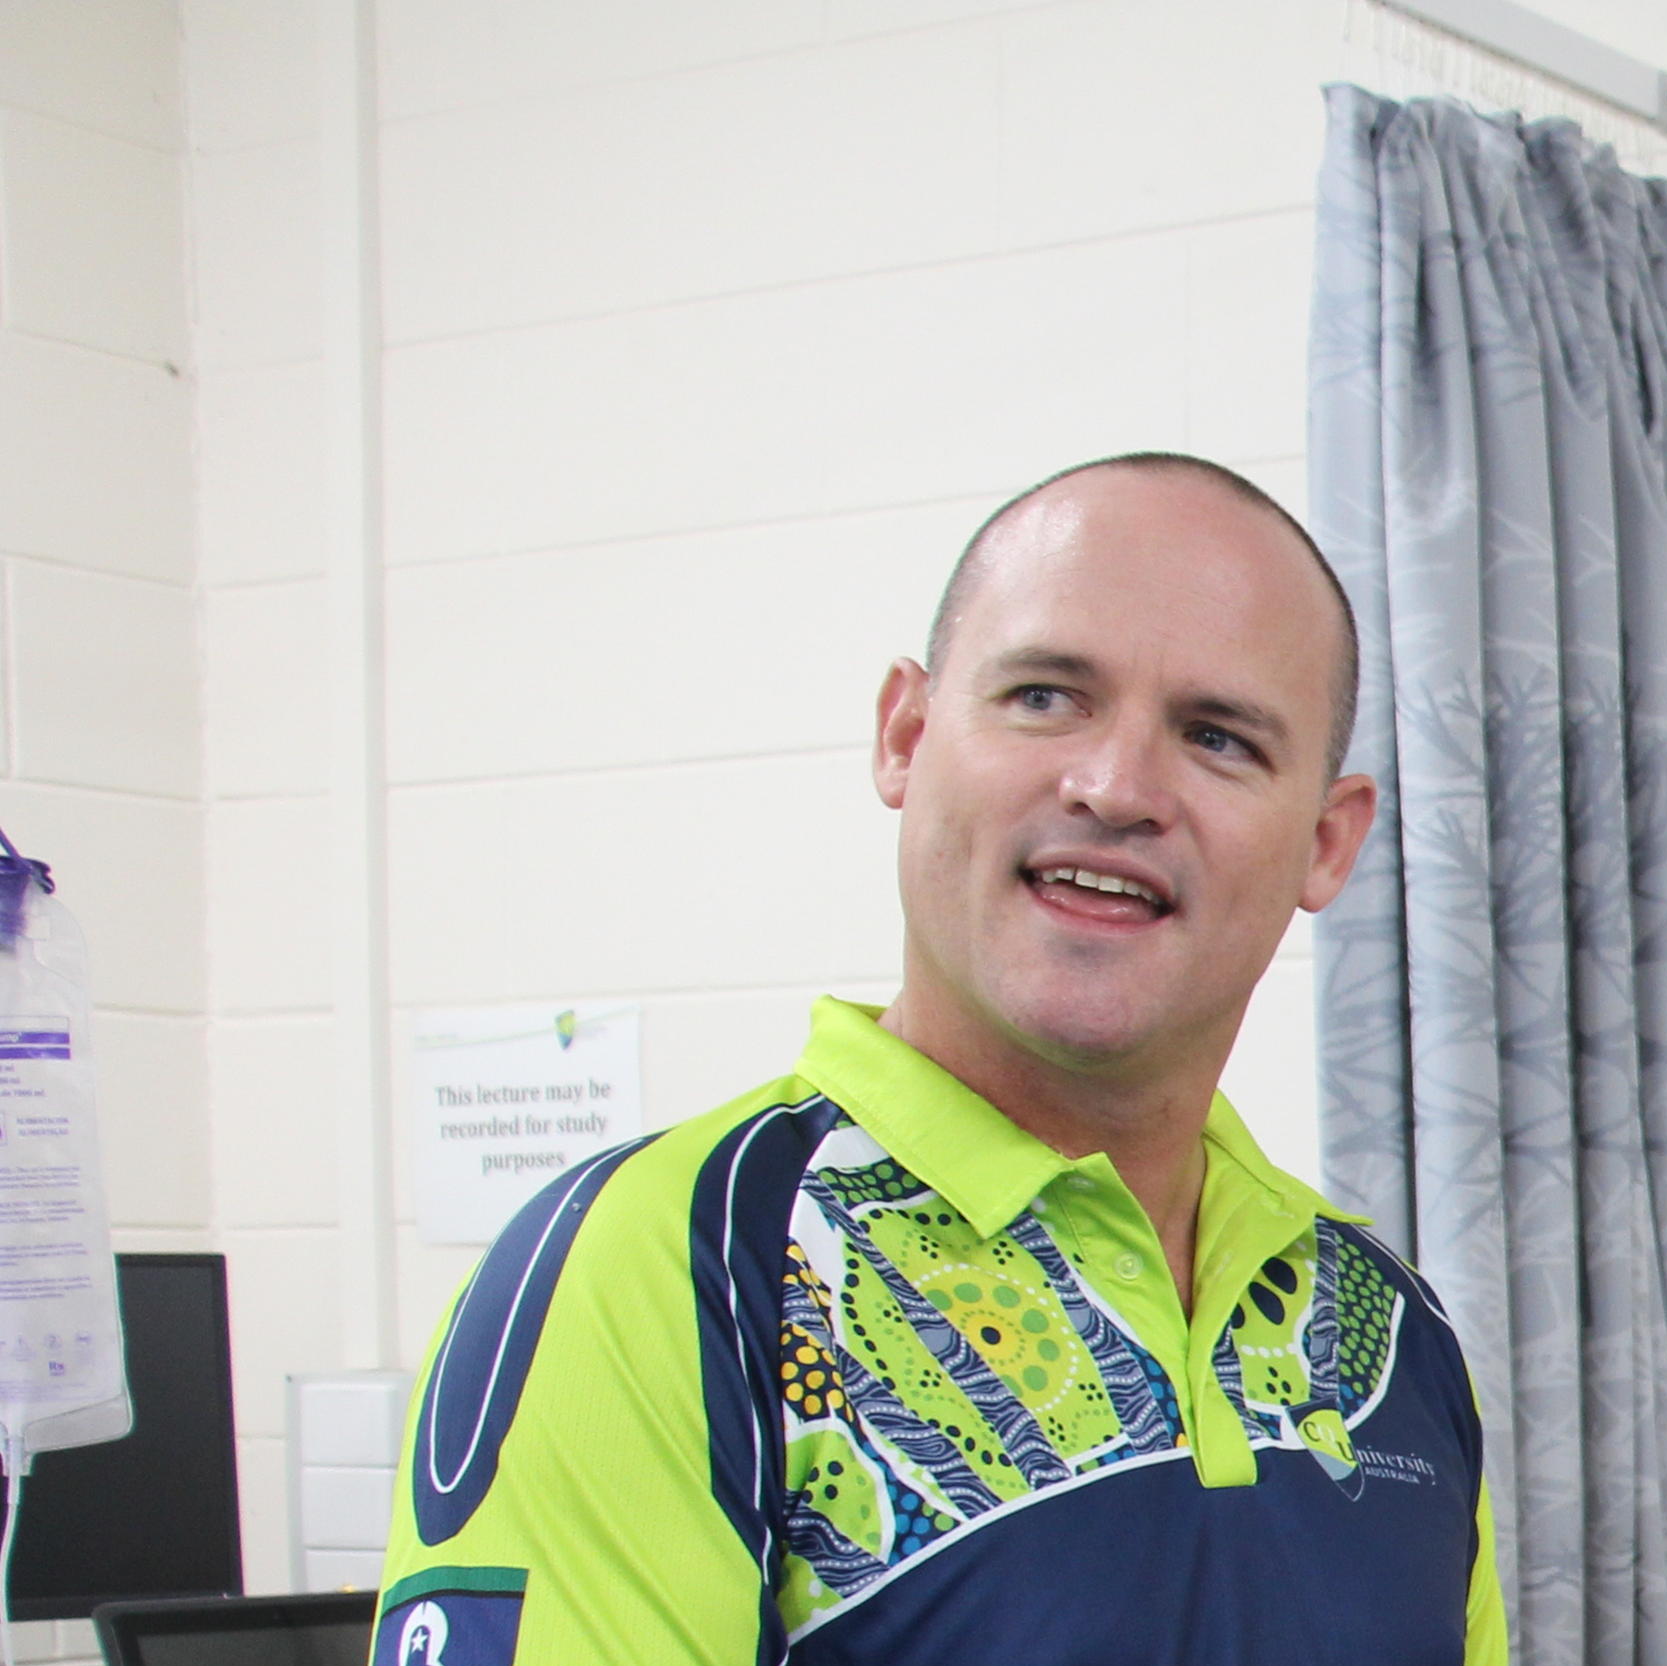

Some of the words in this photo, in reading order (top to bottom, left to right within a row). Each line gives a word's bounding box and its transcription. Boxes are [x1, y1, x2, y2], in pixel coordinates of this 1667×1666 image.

[435, 1085, 472, 1106] This
[477, 1083, 540, 1104] lecture
[545, 1084, 583, 1104] may
[588, 1077, 611, 1098] be
[440, 1116, 519, 1139] recorded
[524, 1114, 552, 1135] for
[556, 1112, 608, 1137] study
[481, 1152, 565, 1176] purposes
[1365, 1466, 1420, 1484] AUSTRALIA
